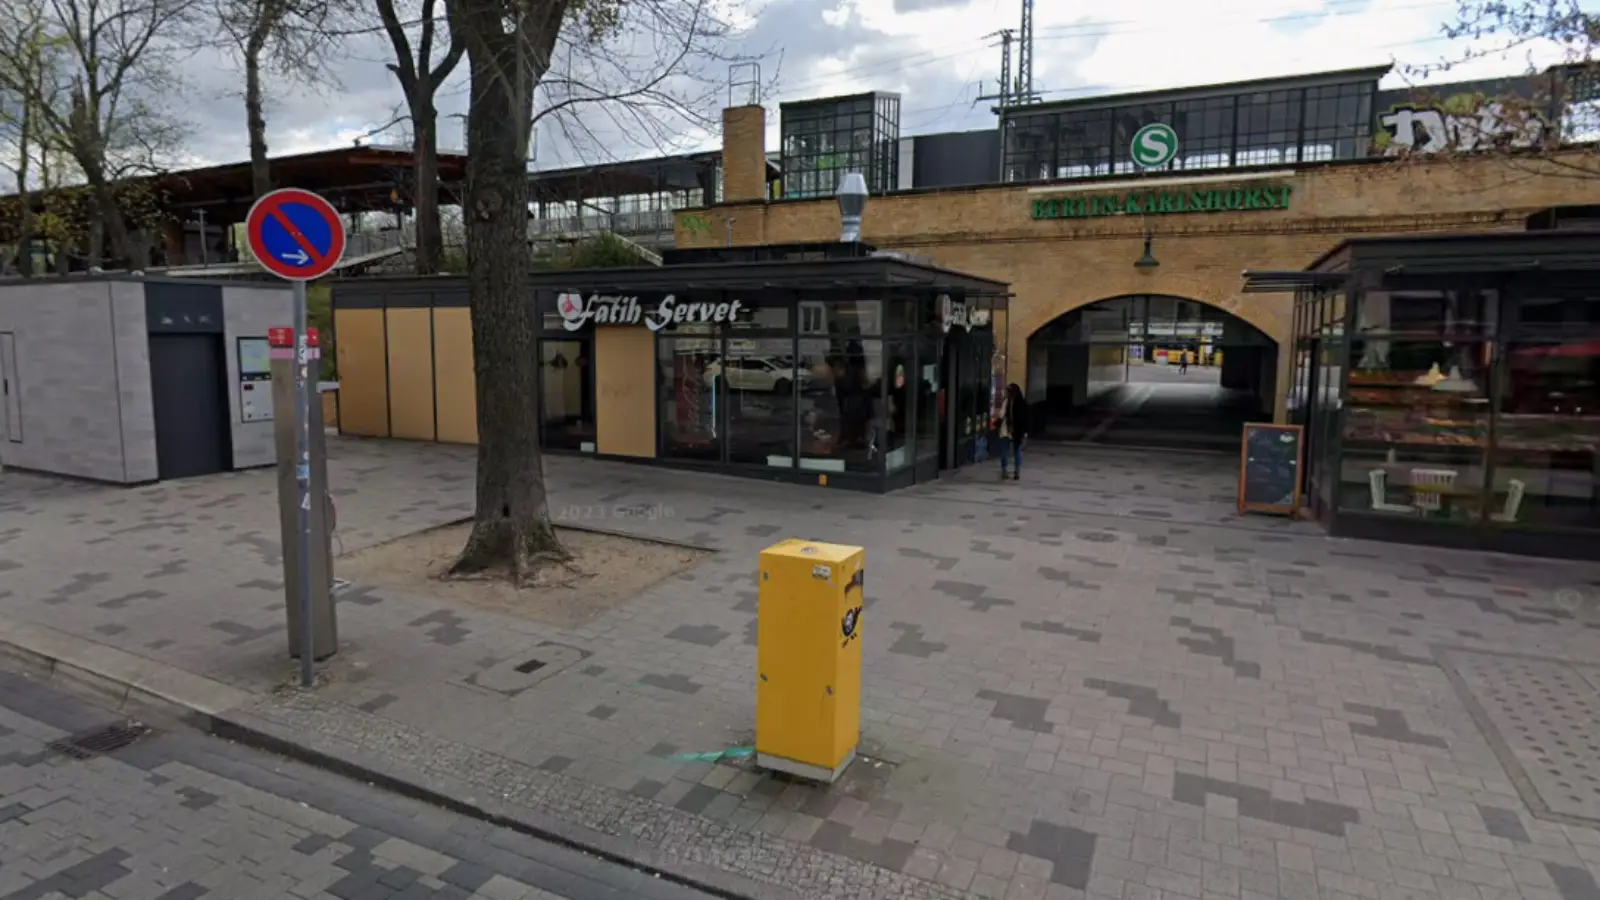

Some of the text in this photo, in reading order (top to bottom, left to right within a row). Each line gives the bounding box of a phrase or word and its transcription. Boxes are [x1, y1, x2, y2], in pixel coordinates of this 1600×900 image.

[1139, 128, 1170, 163] S
[1031, 185, 1293, 220] BERLIN-KARLSHORST
[563, 294, 742, 331] Fatih Servet
